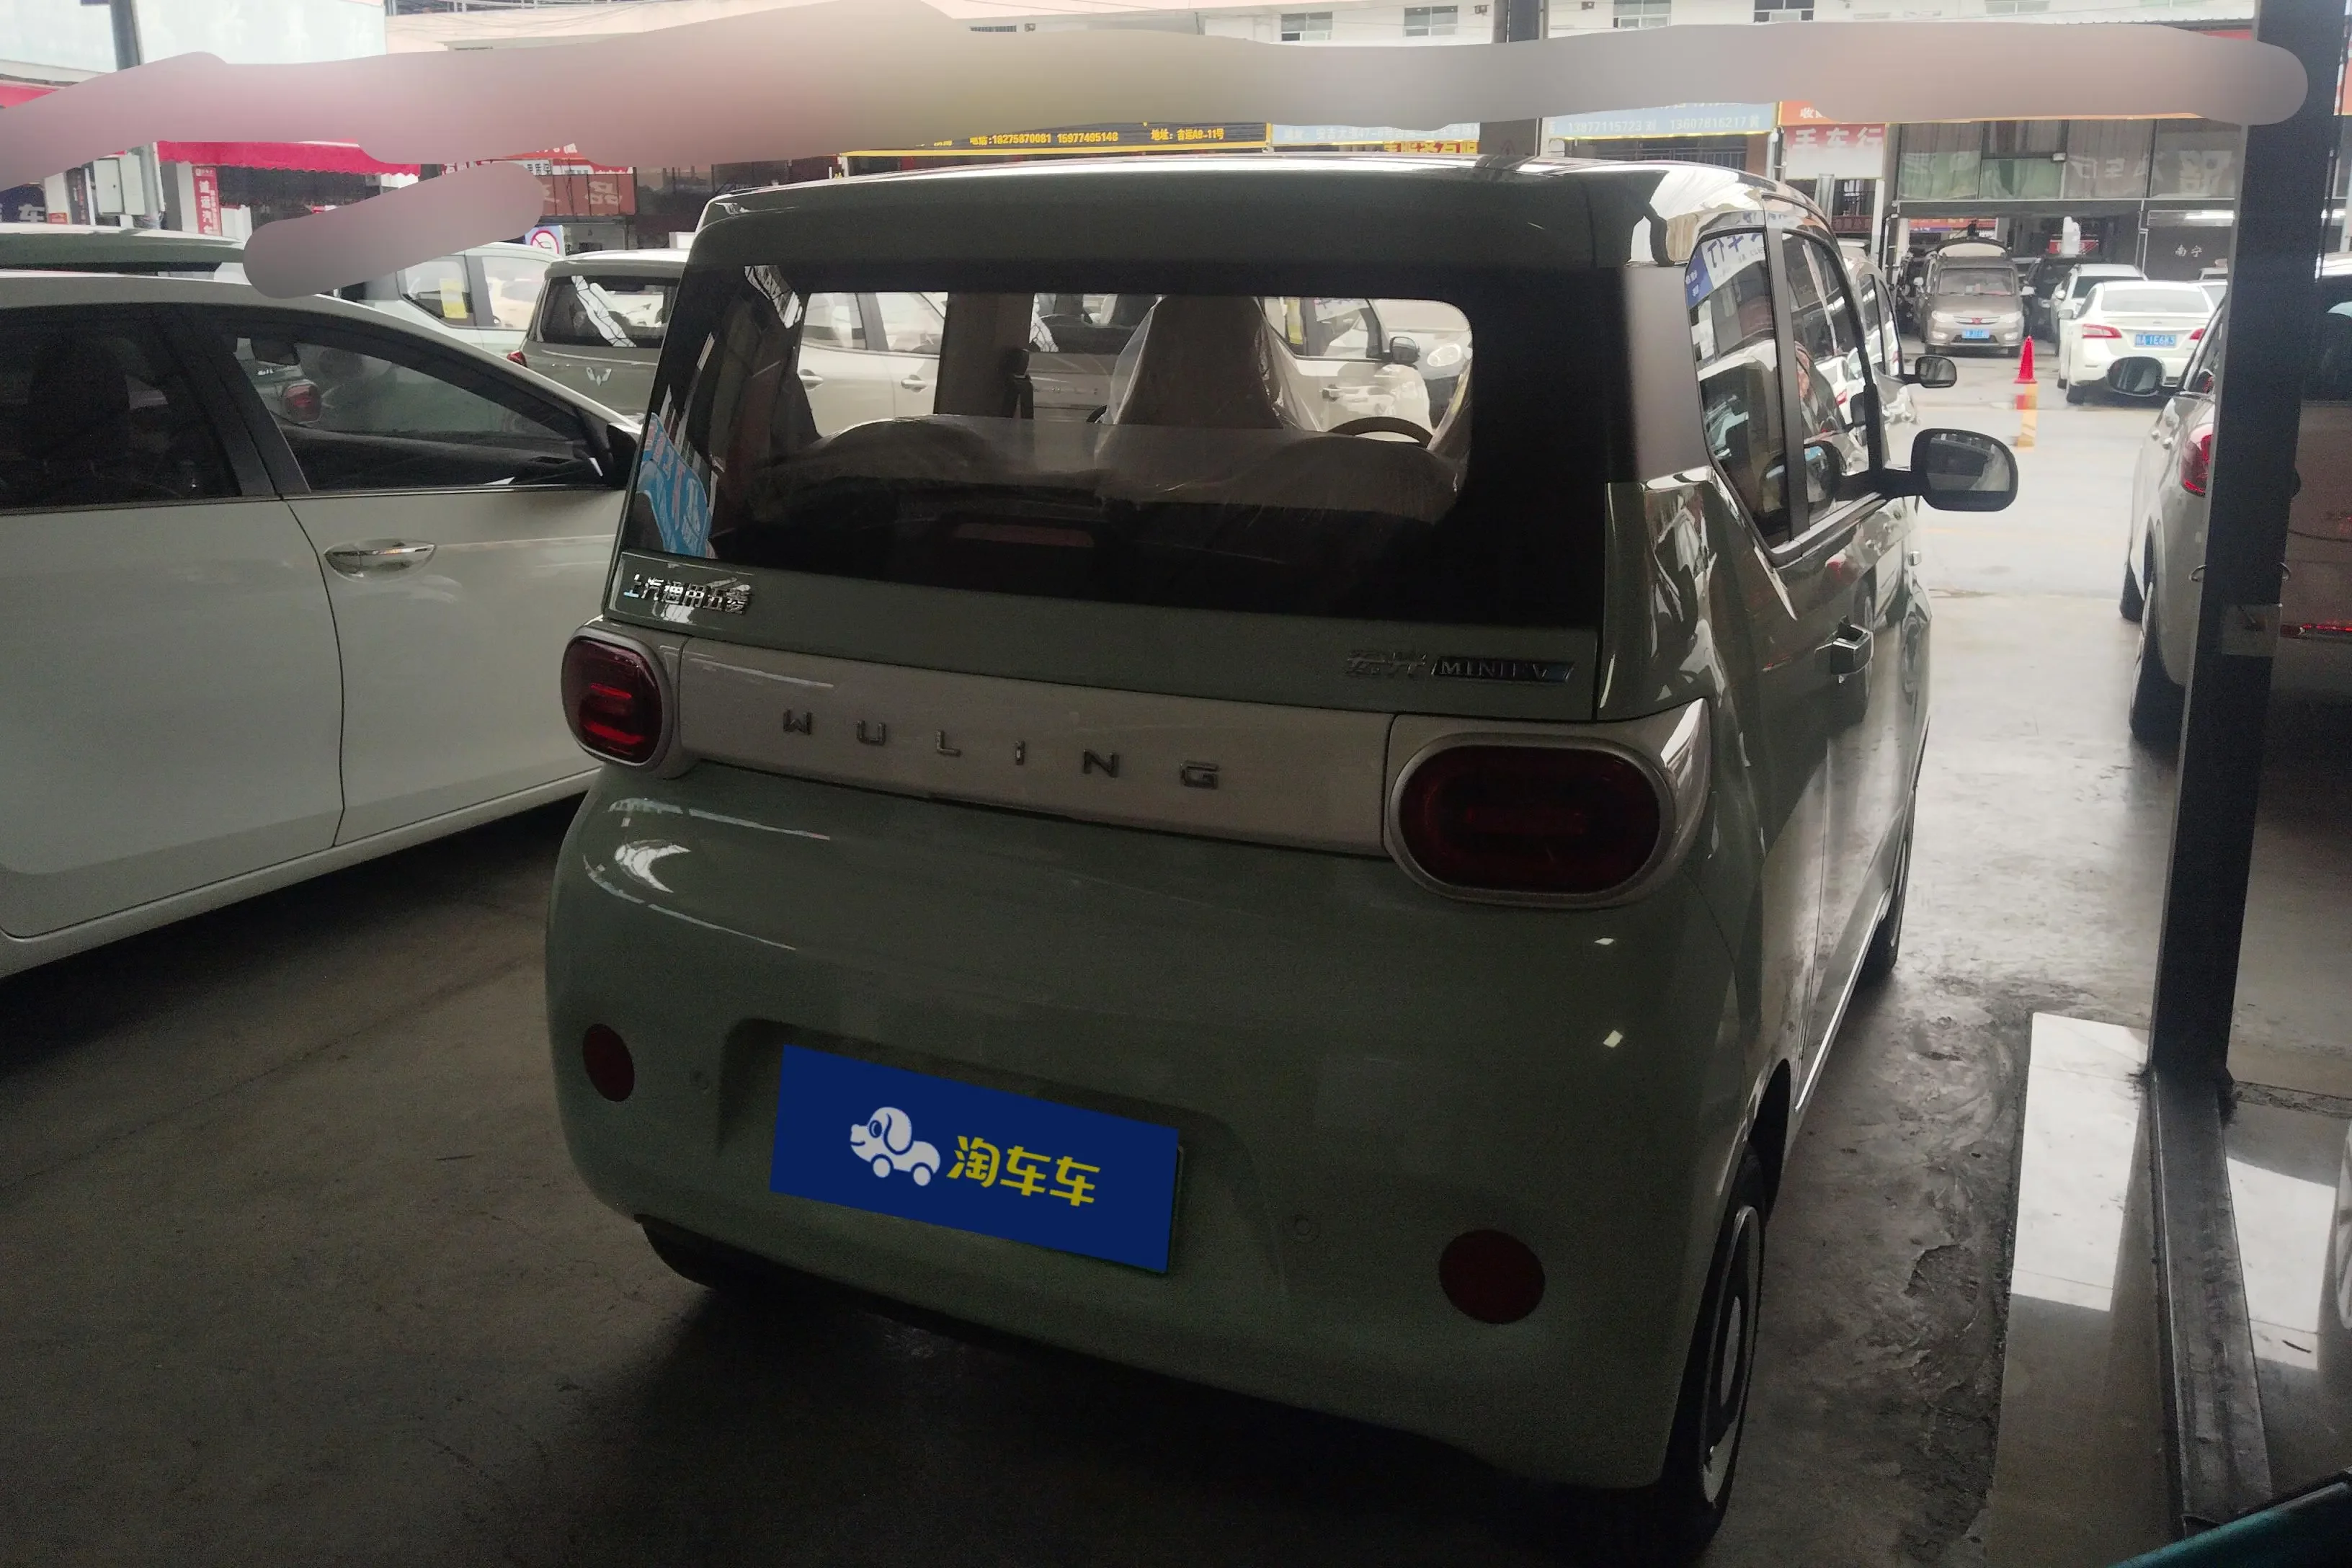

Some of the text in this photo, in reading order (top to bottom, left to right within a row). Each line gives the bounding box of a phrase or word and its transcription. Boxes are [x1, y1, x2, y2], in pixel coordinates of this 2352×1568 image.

[623, 573, 750, 615] 上汽通用五菱
[783, 708, 1220, 790] WULING
